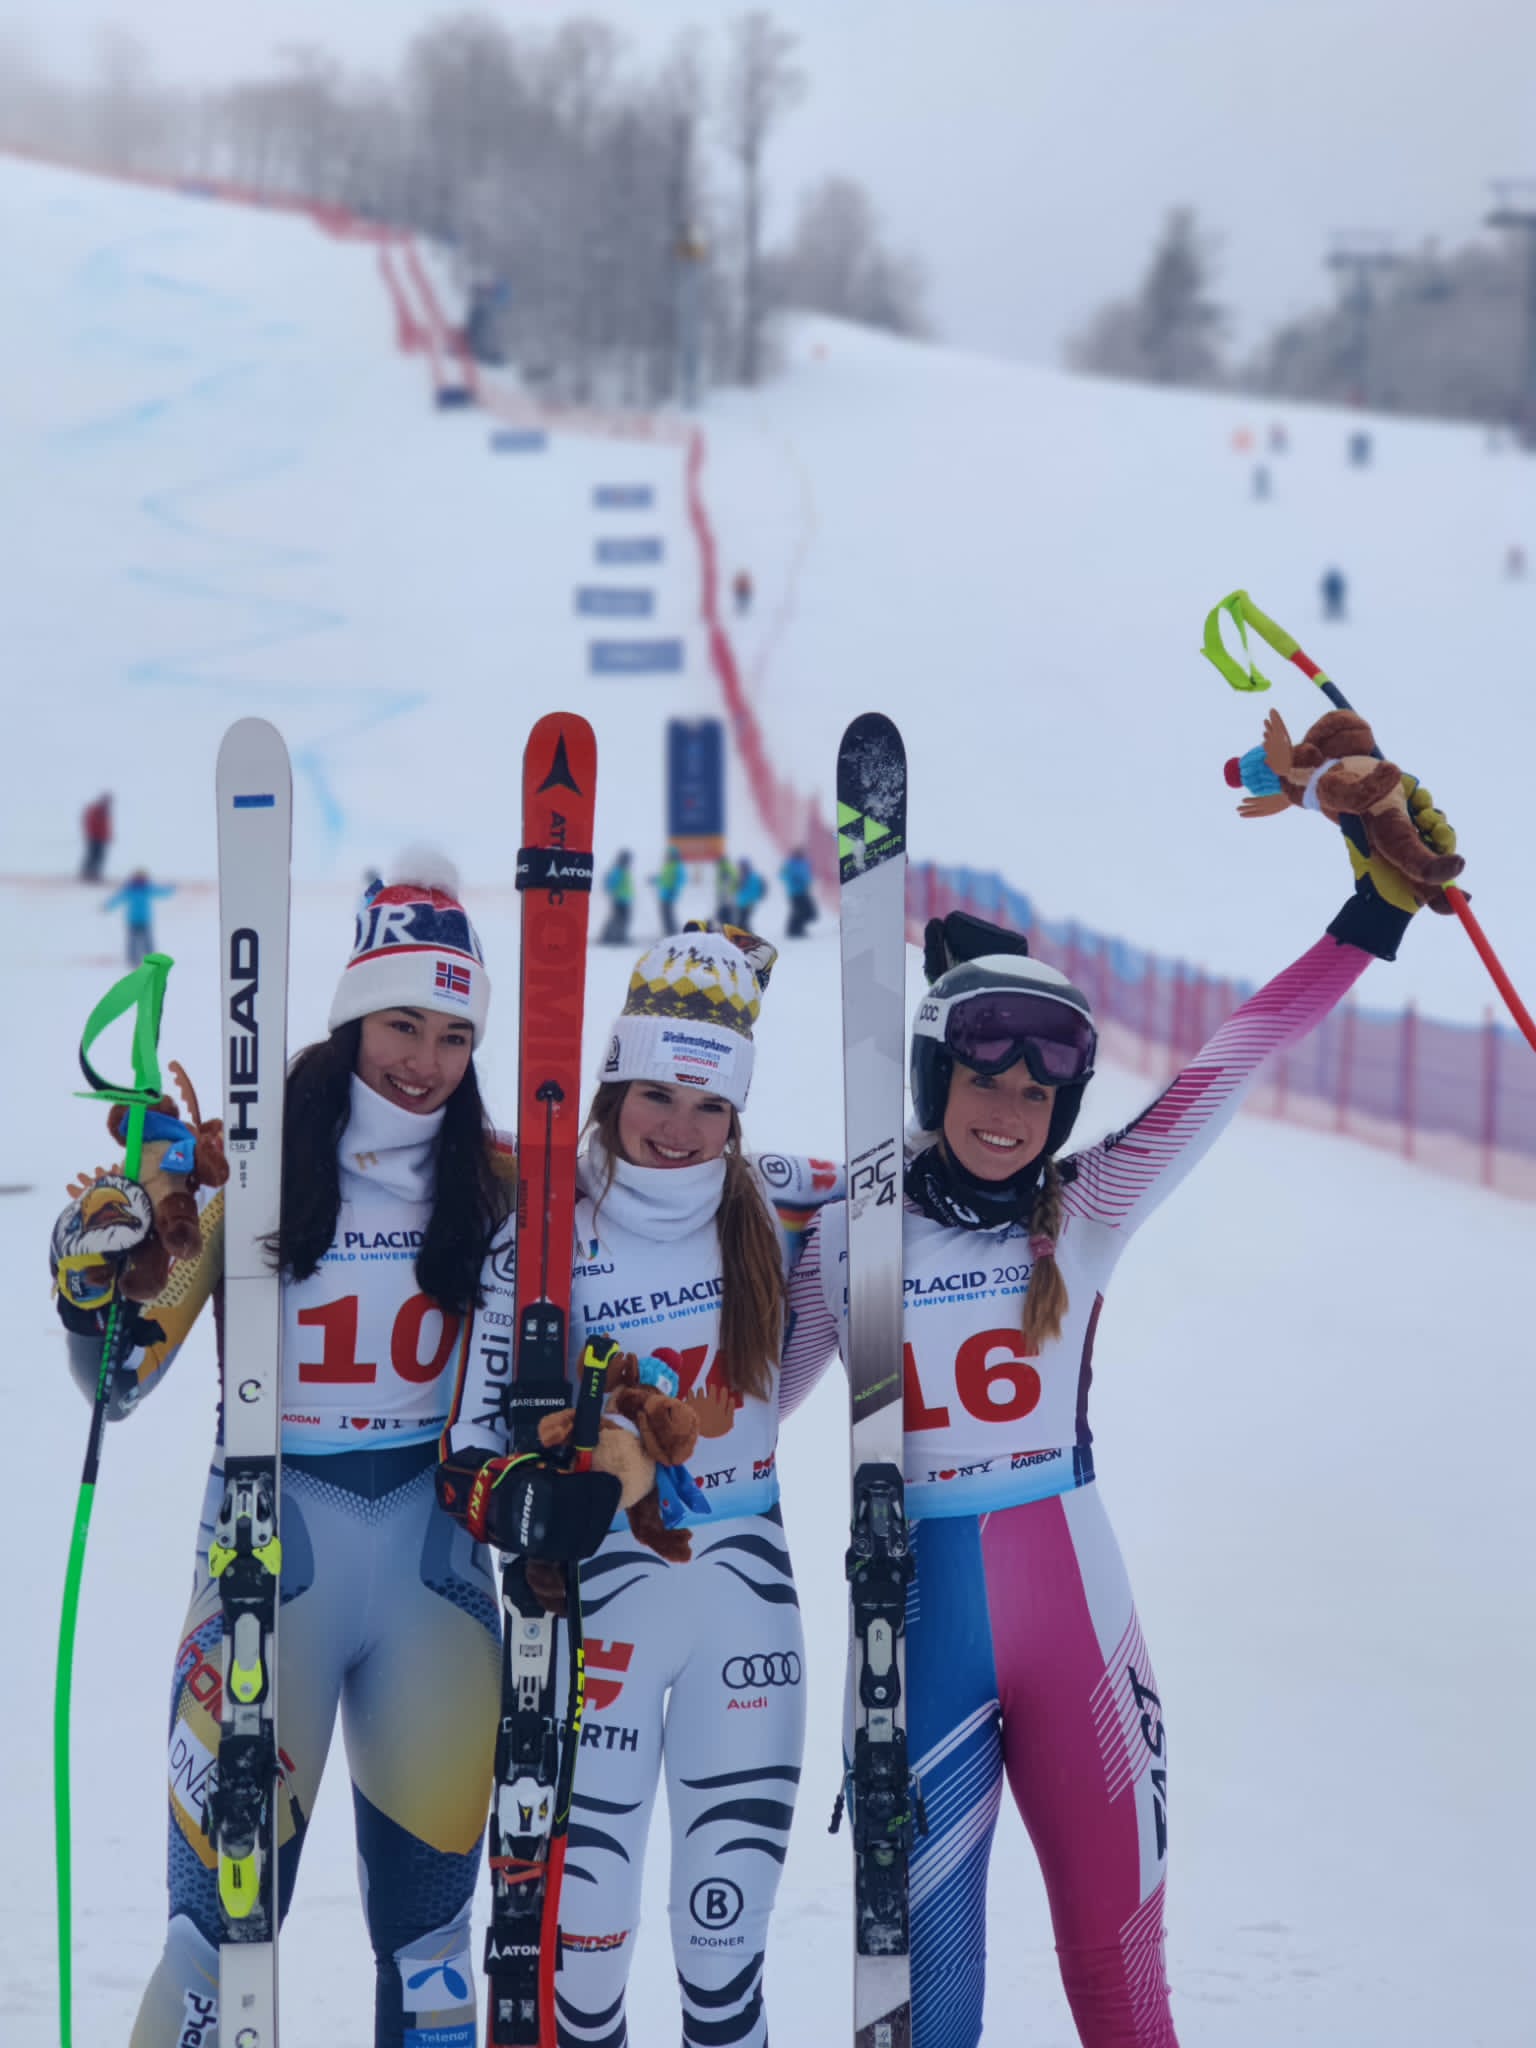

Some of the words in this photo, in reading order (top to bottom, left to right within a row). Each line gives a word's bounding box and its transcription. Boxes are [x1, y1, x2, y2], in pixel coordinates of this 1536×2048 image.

[560, 866, 593, 878] ATOM
[229, 927, 259, 1141] HEAD
[344, 1231, 425, 1250] PLACID
[320, 1251, 356, 1262] ORLD
[361, 1250, 417, 1261] UNIVERS
[903, 1271, 987, 1297] PLACID
[583, 1295, 646, 1323] LAKE
[649, 1277, 725, 1311] PLACID
[912, 1288, 997, 1308] UNIVERSITY
[1000, 1285, 1030, 1297] GAM
[619, 1314, 665, 1330] WORLD
[668, 1300, 723, 1320] UNIVERS
[297, 1293, 461, 1385] 10
[472, 1333, 512, 1436] Audi
[1010, 1449, 1062, 1471] KARBON
[470, 1467, 489, 1520] LEKI
[727, 1696, 768, 1711] Audi
[556, 1717, 639, 1753] RTH
[501, 1944, 541, 1957] ATOM
[689, 1934, 746, 1948] BOGNER
